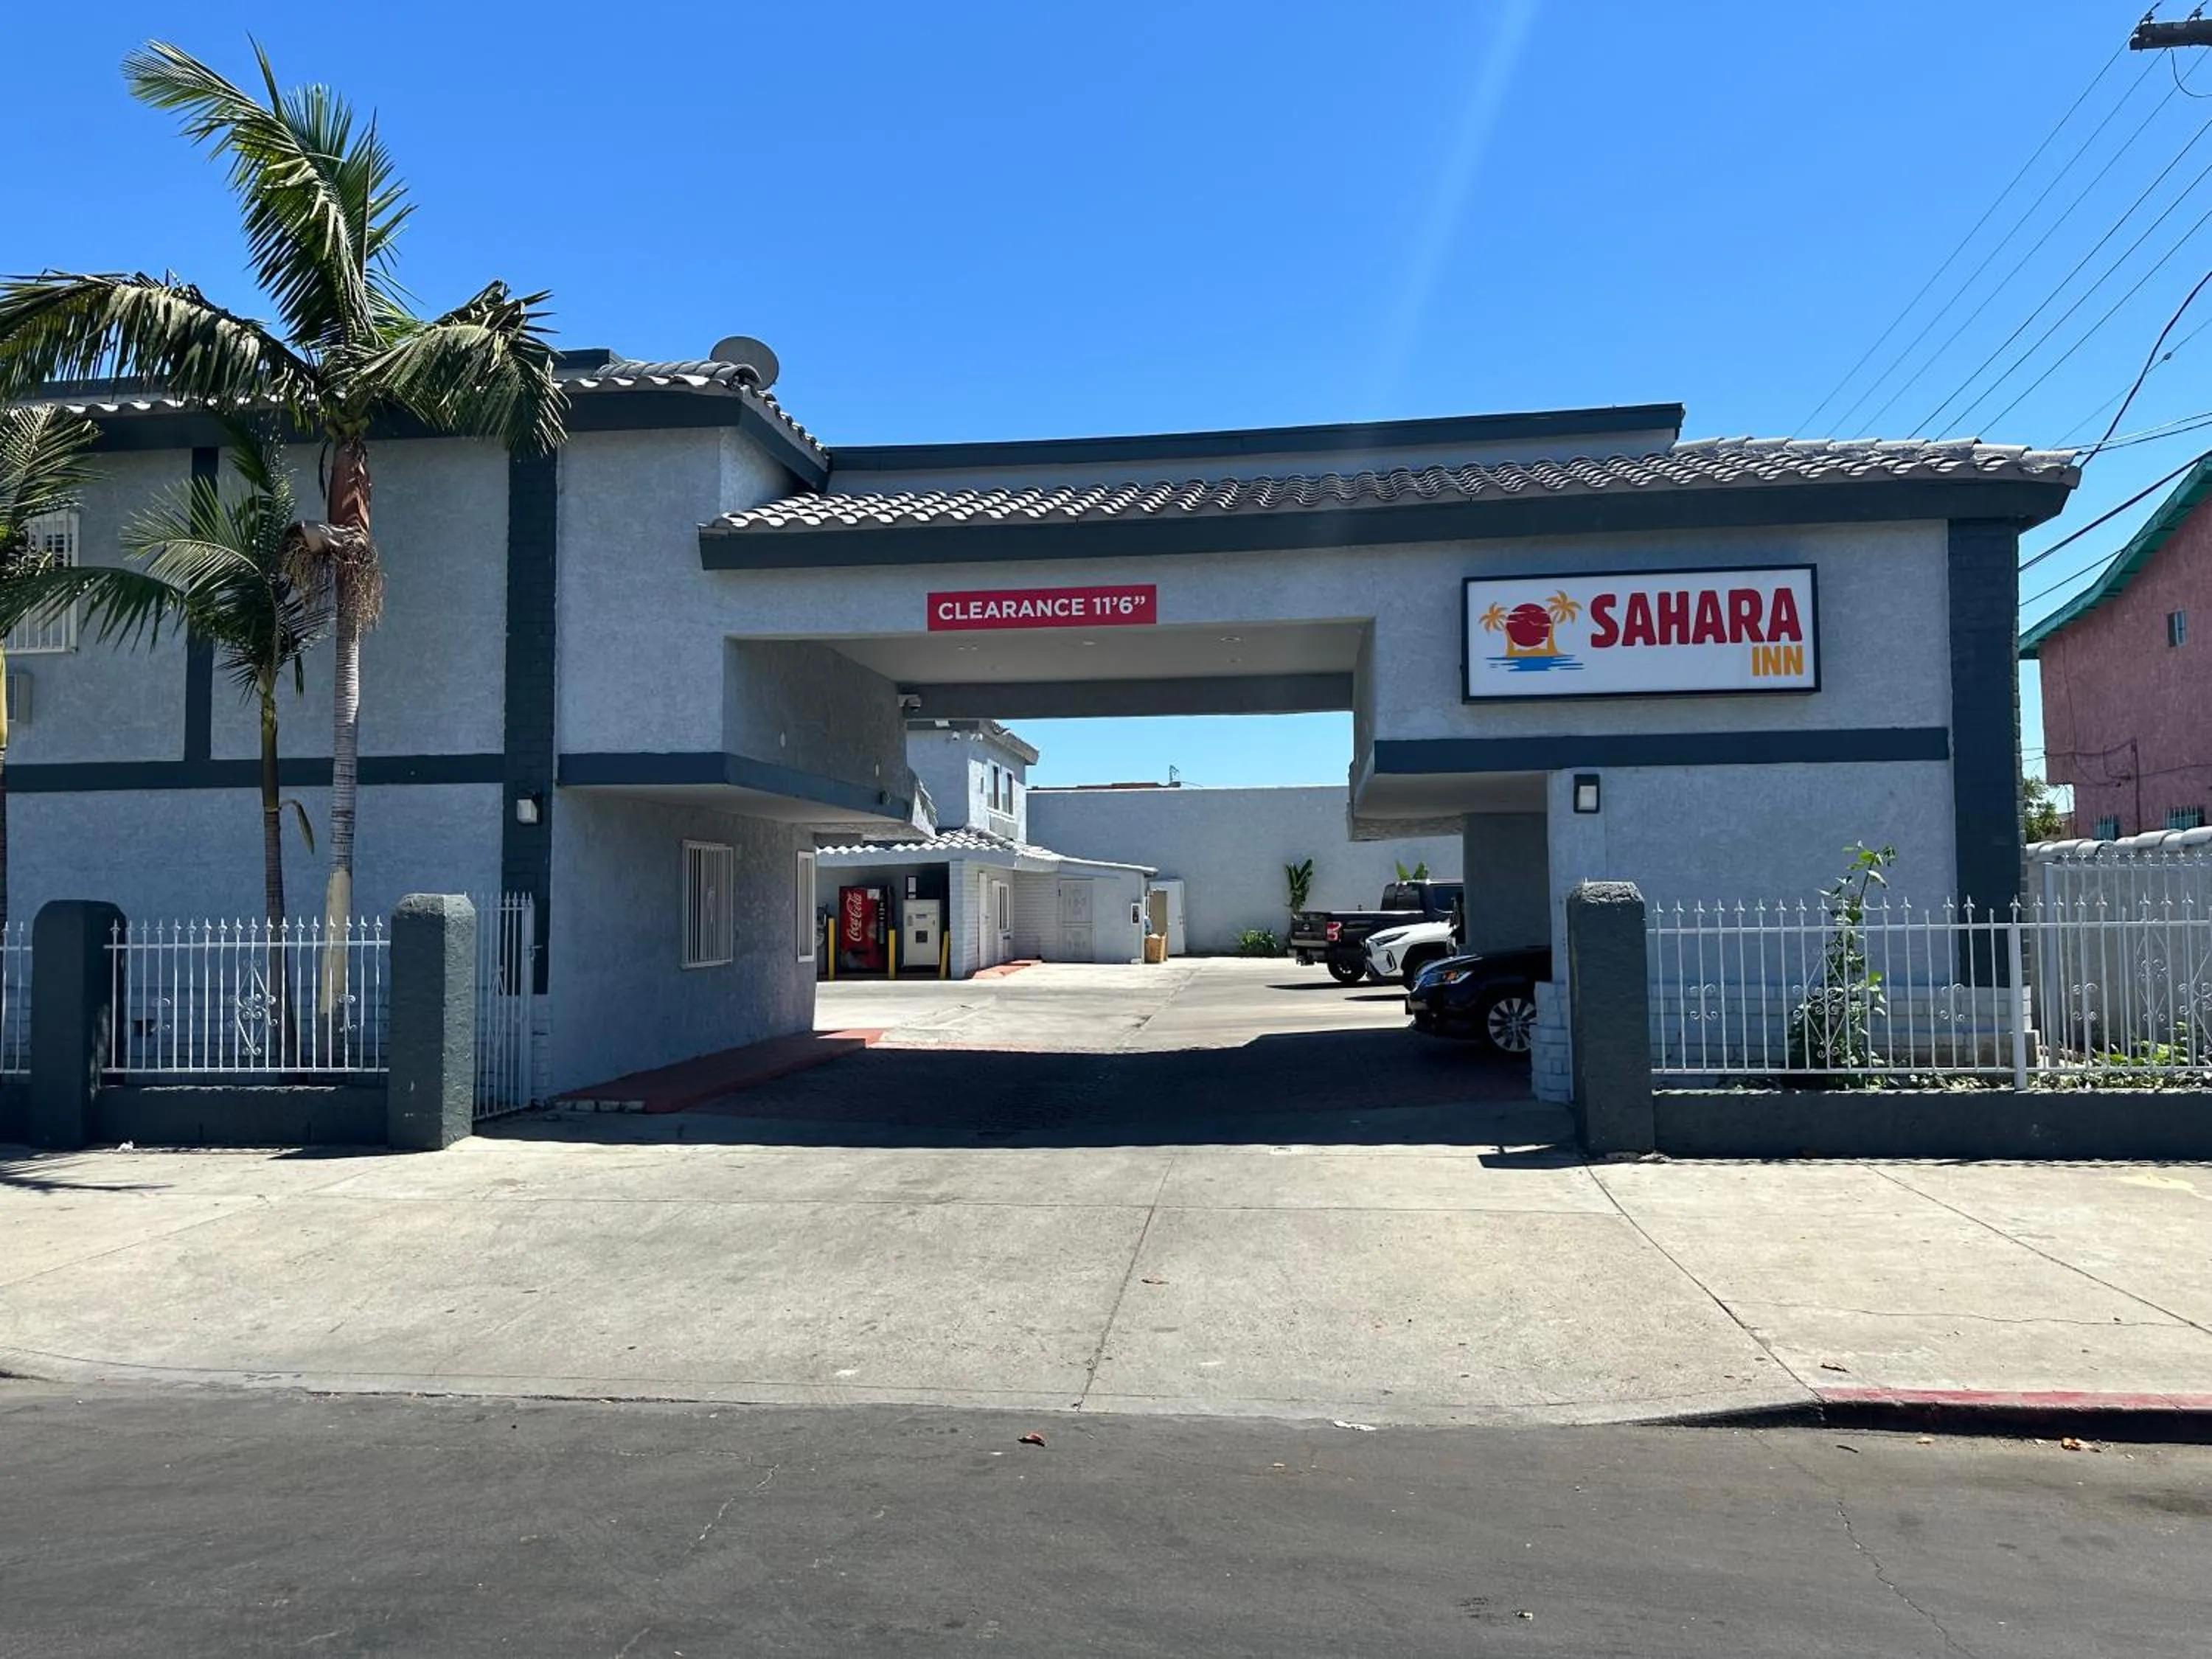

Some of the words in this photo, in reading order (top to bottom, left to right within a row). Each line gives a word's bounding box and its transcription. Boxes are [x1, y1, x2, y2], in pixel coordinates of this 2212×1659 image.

[938, 598, 1085, 620] CLEARANCE
[1590, 588, 1803, 648] SAHARA
[1752, 645, 1804, 676] INN
